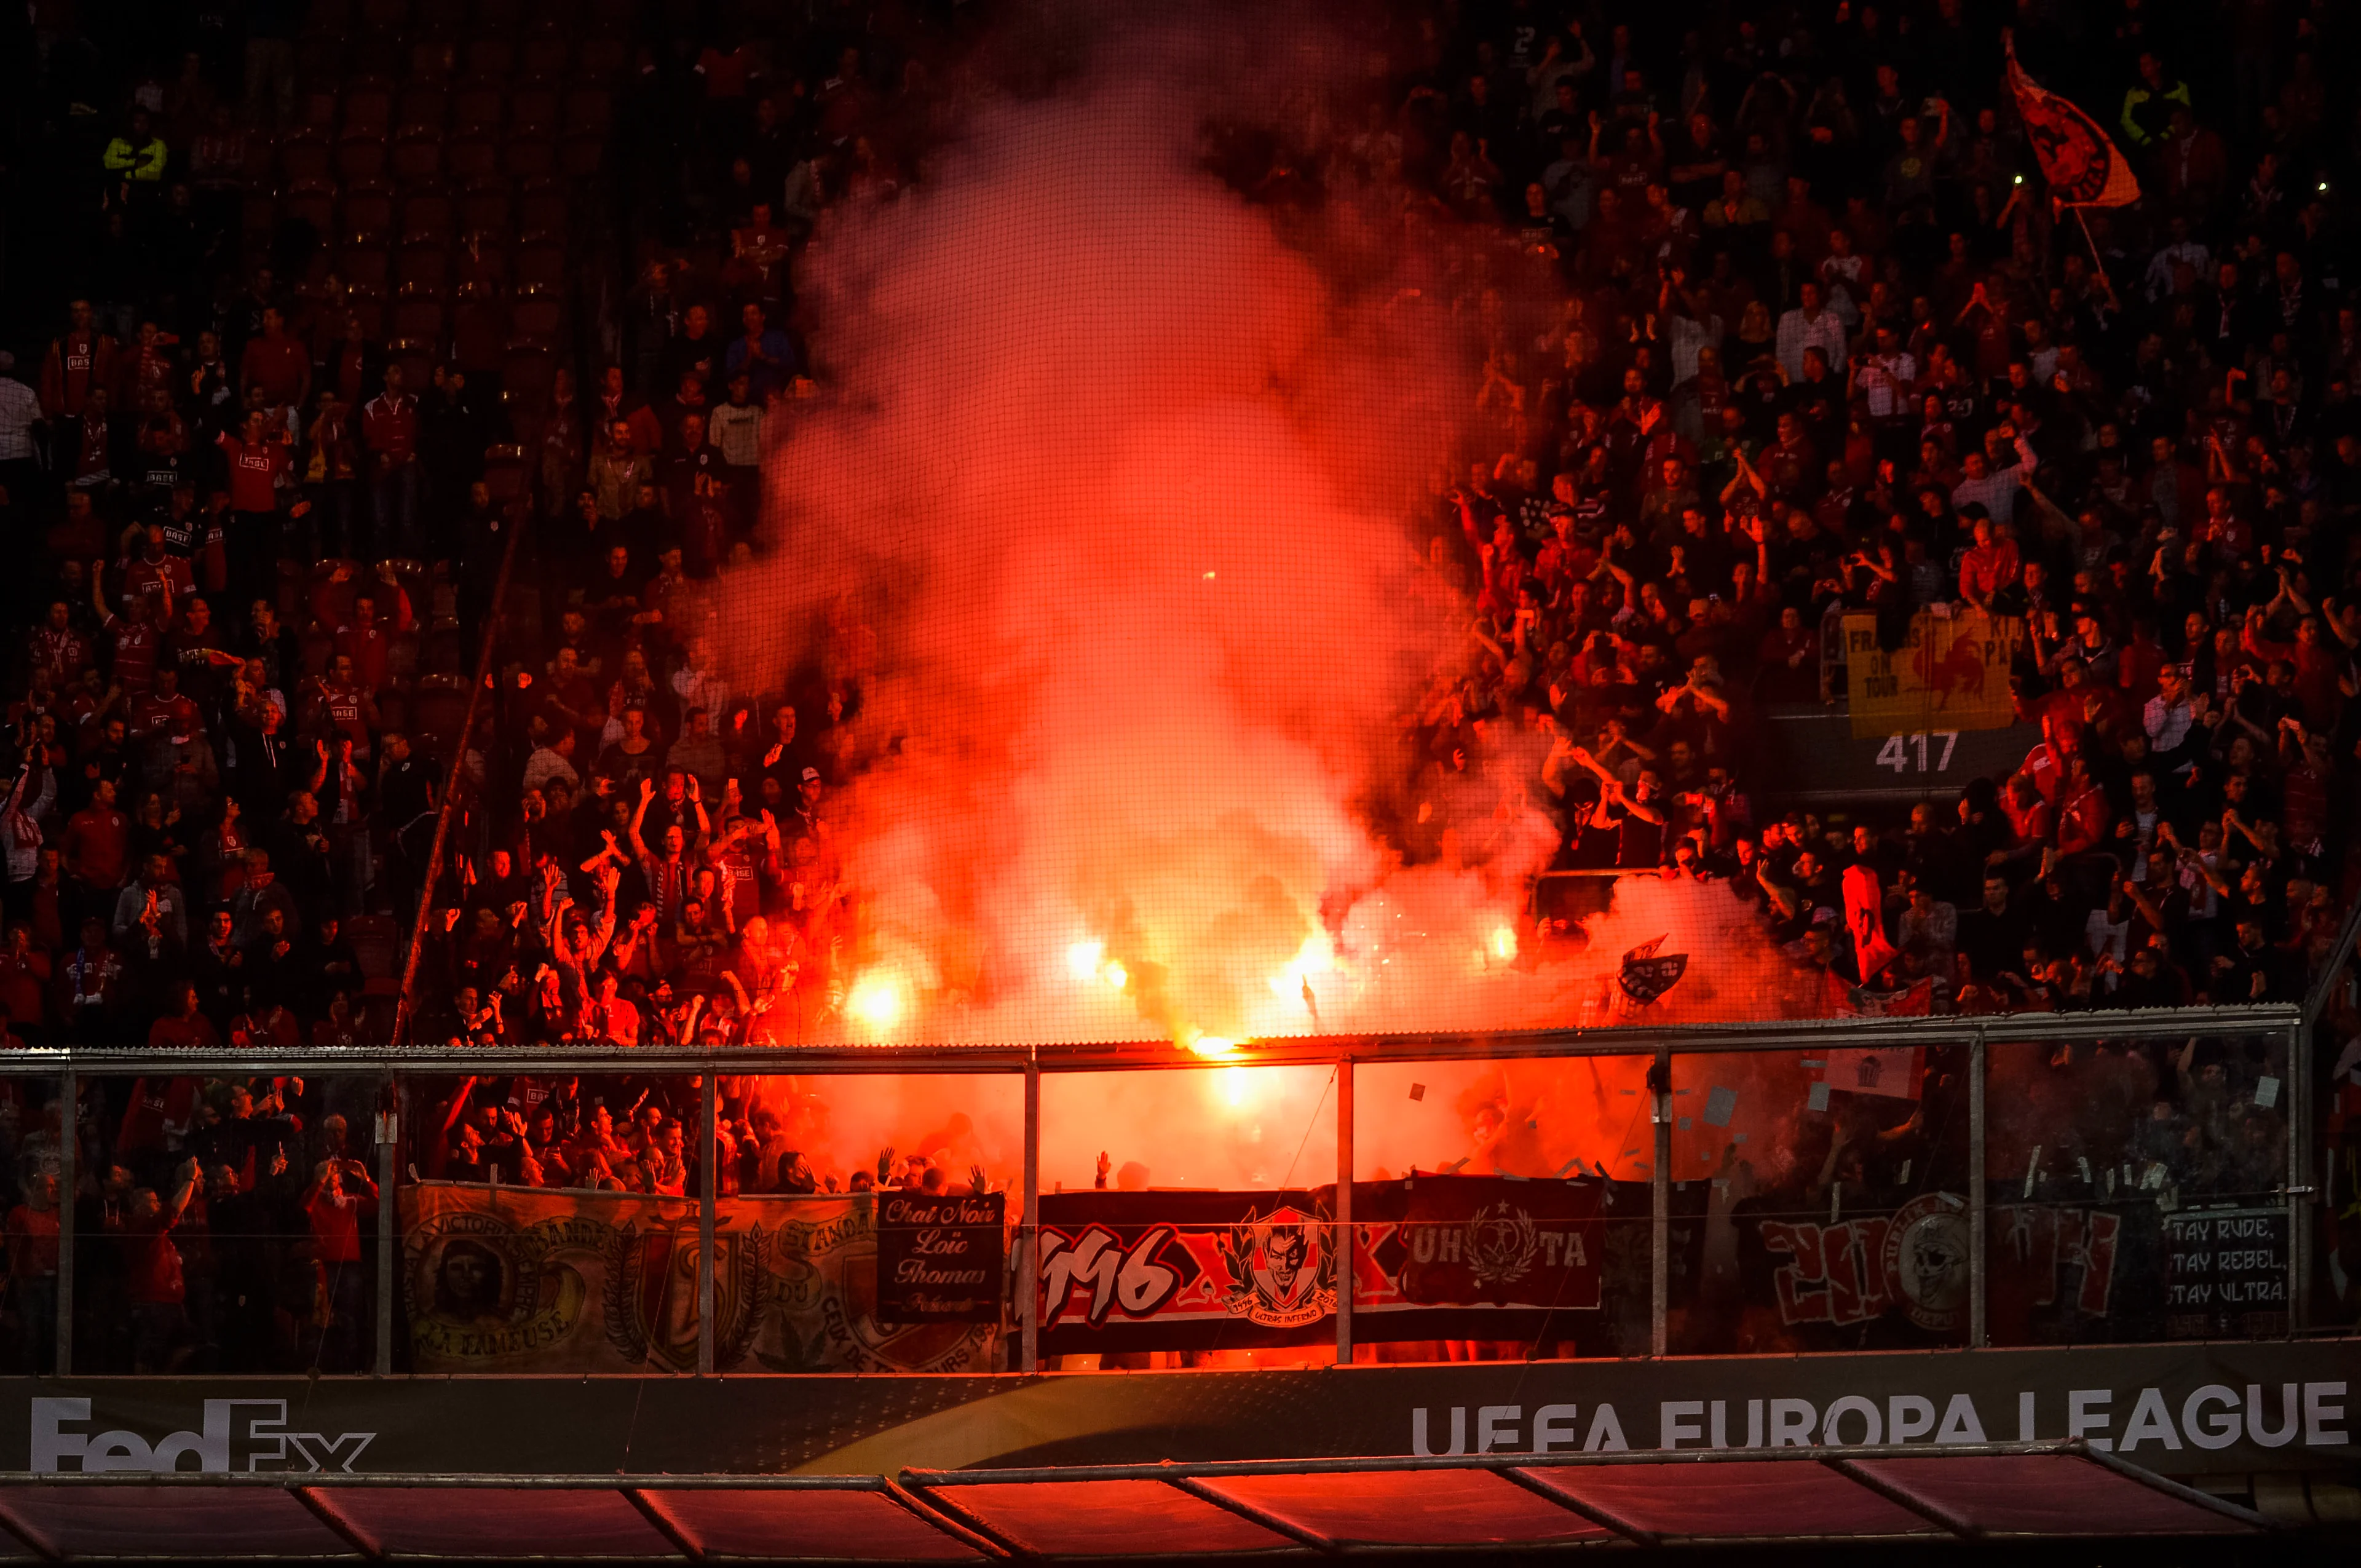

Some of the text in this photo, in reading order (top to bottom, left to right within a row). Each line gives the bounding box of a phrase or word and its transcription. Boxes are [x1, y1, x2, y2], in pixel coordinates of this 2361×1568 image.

[149, 473, 174, 482] BASE
[166, 528, 190, 544] BASE
[1865, 675, 1898, 697] TOUR
[1876, 731, 1959, 773] 417
[885, 1199, 996, 1225] Chat Noir
[781, 1212, 878, 1250] STANDA
[911, 1229, 969, 1254] Loïc
[2172, 1218, 2274, 1241] TAY RUDE,
[1413, 1227, 1588, 1267] UH TA
[895, 1258, 986, 1285] Thomas
[2169, 1249, 2288, 1273] TAY REBEL,
[774, 1281, 809, 1303] DU
[821, 1295, 851, 1348] CEUX
[1233, 1297, 1253, 1312] 1996
[1254, 1310, 1281, 1323] ULTRAS
[1284, 1308, 1317, 1323] INFERNO
[1412, 1381, 2349, 1455] UEFA EUROPA LEAGUE
[30, 1396, 377, 1473] FedEx
